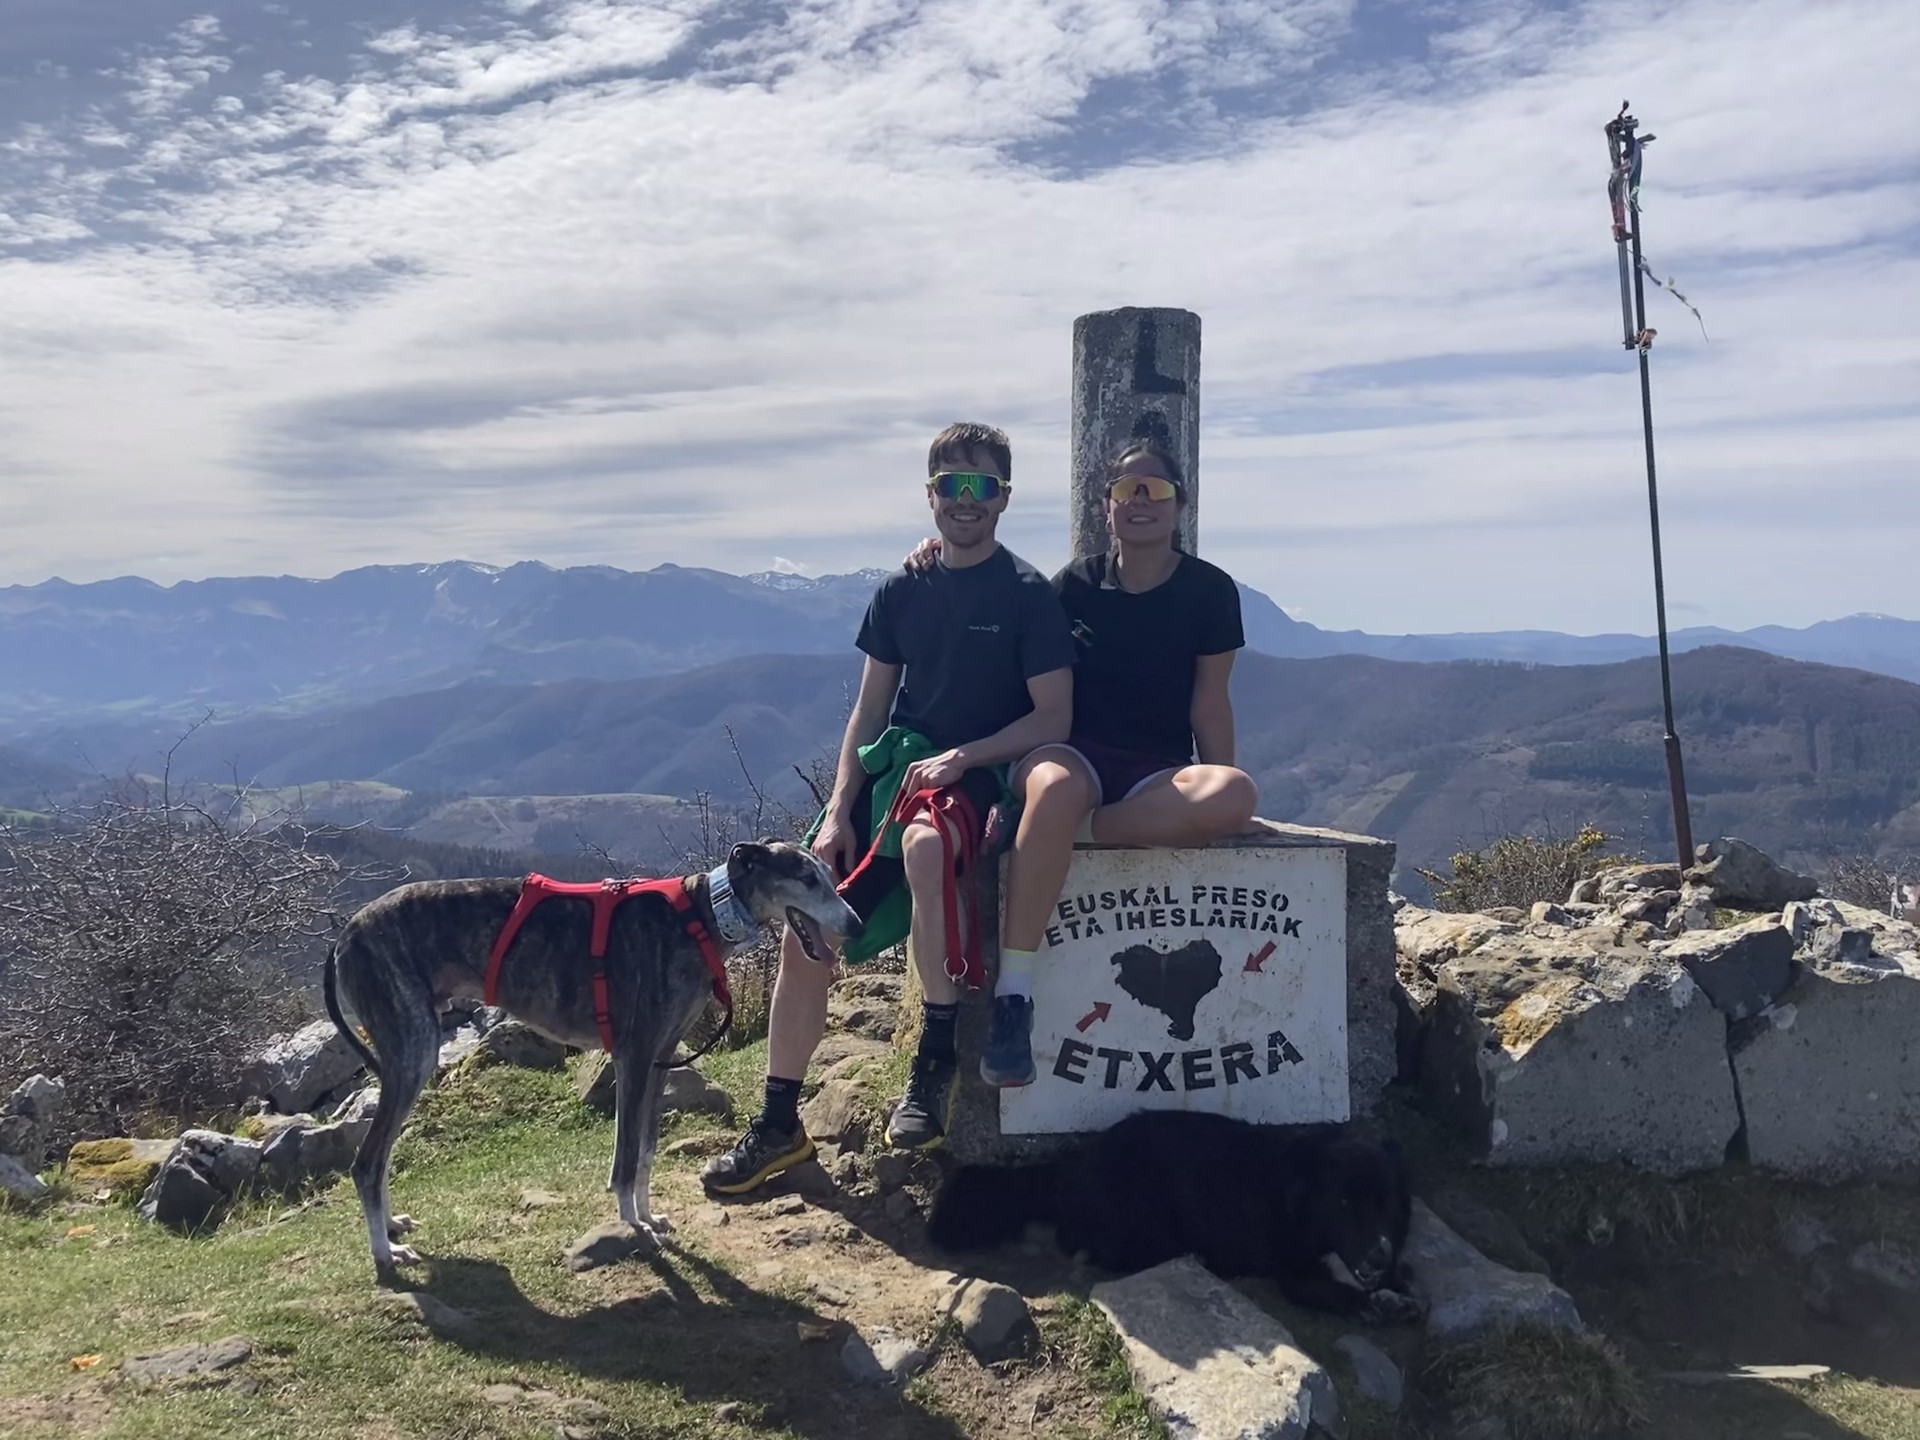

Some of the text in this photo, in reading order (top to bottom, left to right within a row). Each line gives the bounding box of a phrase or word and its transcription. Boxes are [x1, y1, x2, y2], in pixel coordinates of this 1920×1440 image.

[1057, 885, 1289, 921] EUSKAL PRESO
[1045, 908, 1303, 947] ETA IHESLARIAK
[1053, 1030, 1305, 1092] ETXERA
